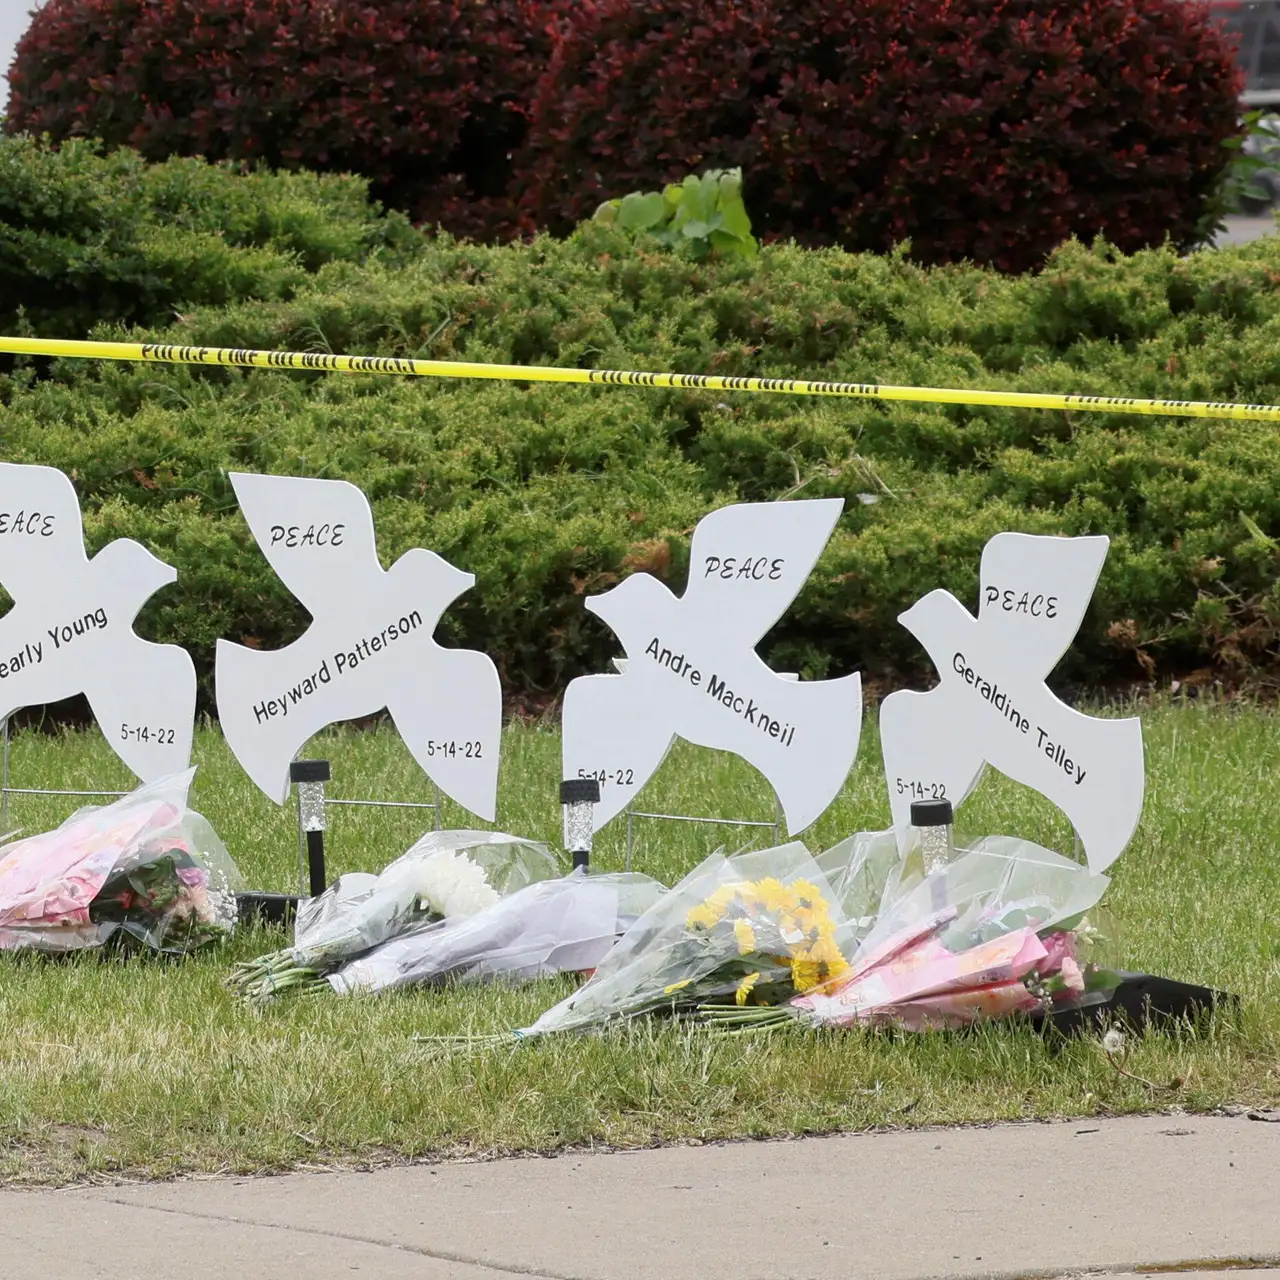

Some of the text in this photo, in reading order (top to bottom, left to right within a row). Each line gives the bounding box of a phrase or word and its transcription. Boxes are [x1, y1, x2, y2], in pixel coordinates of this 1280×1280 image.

[270, 523, 345, 548] PEACE
[704, 556, 785, 581] PEACE
[985, 585, 1058, 619] PEACE
[47, 607, 108, 649] Young
[252, 610, 423, 725] Heyward Patterson
[645, 637, 701, 686] Andre
[952, 652, 1087, 785] Geraldine Talley
[121, 723, 175, 744] 5-14-22
[427, 740, 482, 759] 5-14-22
[896, 777, 947, 801] 5-14-22
